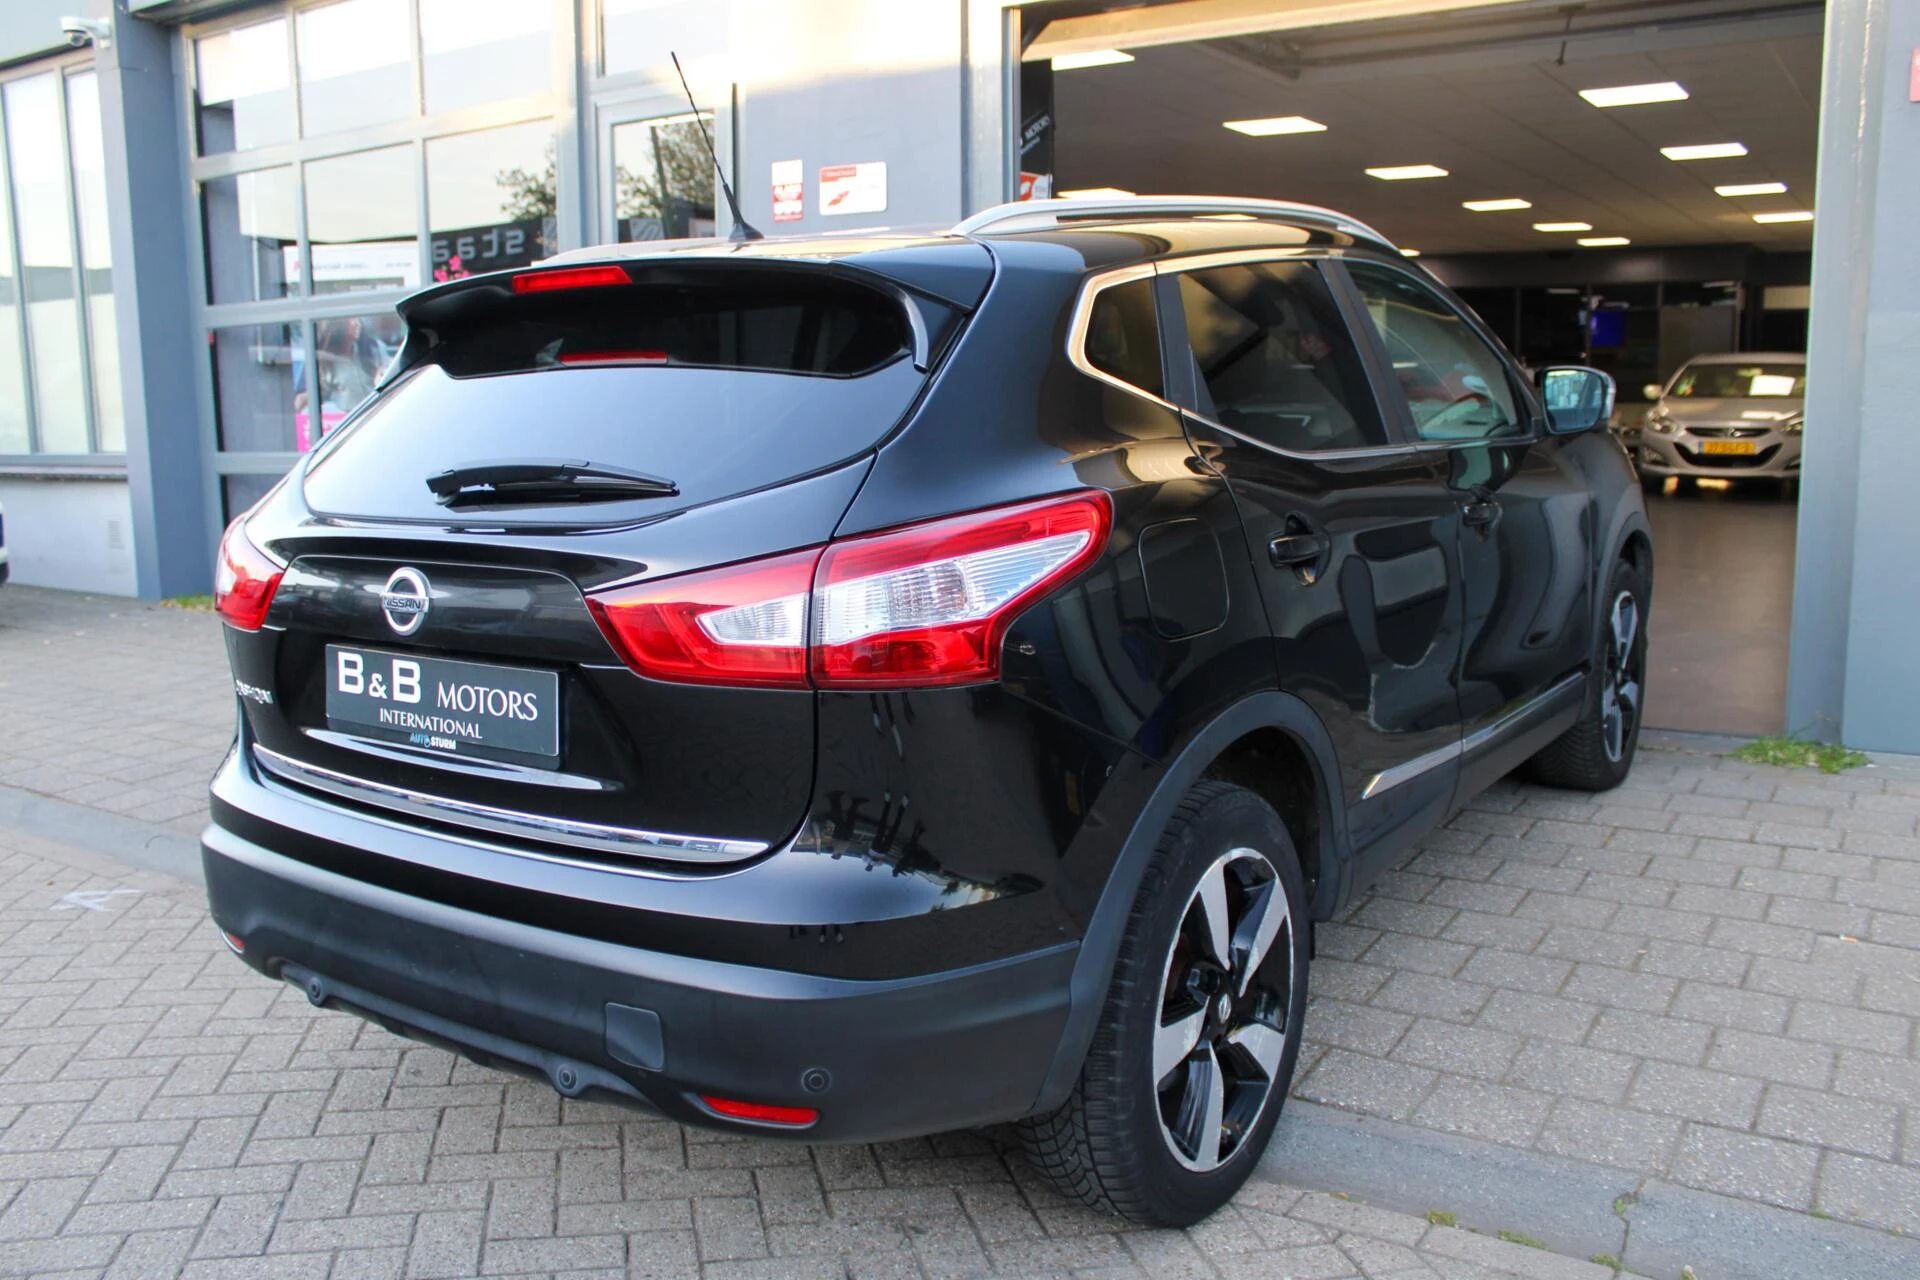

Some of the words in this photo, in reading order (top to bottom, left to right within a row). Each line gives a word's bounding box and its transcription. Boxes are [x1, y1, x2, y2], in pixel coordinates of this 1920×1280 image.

[385, 598, 421, 609] NISSAN
[437, 681, 538, 721] MOTORS
[379, 707, 483, 739] INTERNATIONAL
